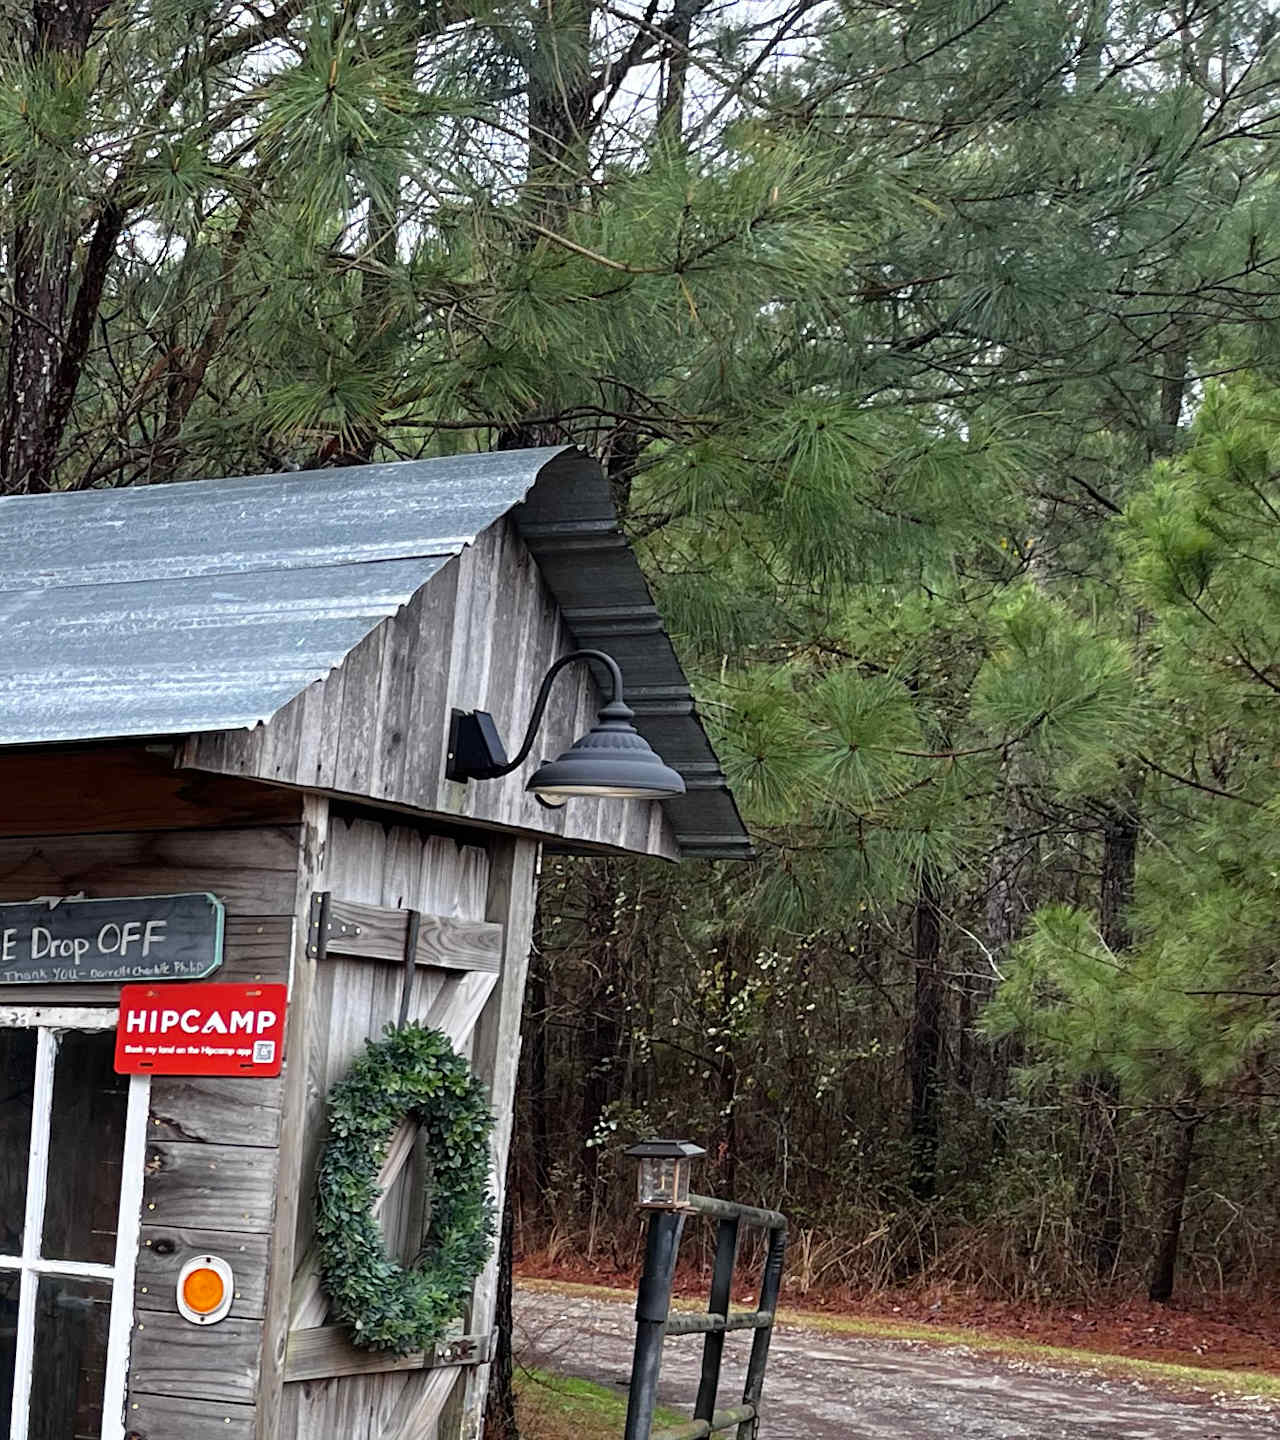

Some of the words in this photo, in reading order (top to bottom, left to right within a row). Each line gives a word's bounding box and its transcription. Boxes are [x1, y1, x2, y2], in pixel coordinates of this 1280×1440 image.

[31, 927, 90, 965] Drop
[98, 920, 168, 957] OFF
[4, 969, 48, 981] Thank
[126, 1009, 277, 1034] HIPCAMP
[145, 1047, 157, 1055] my
